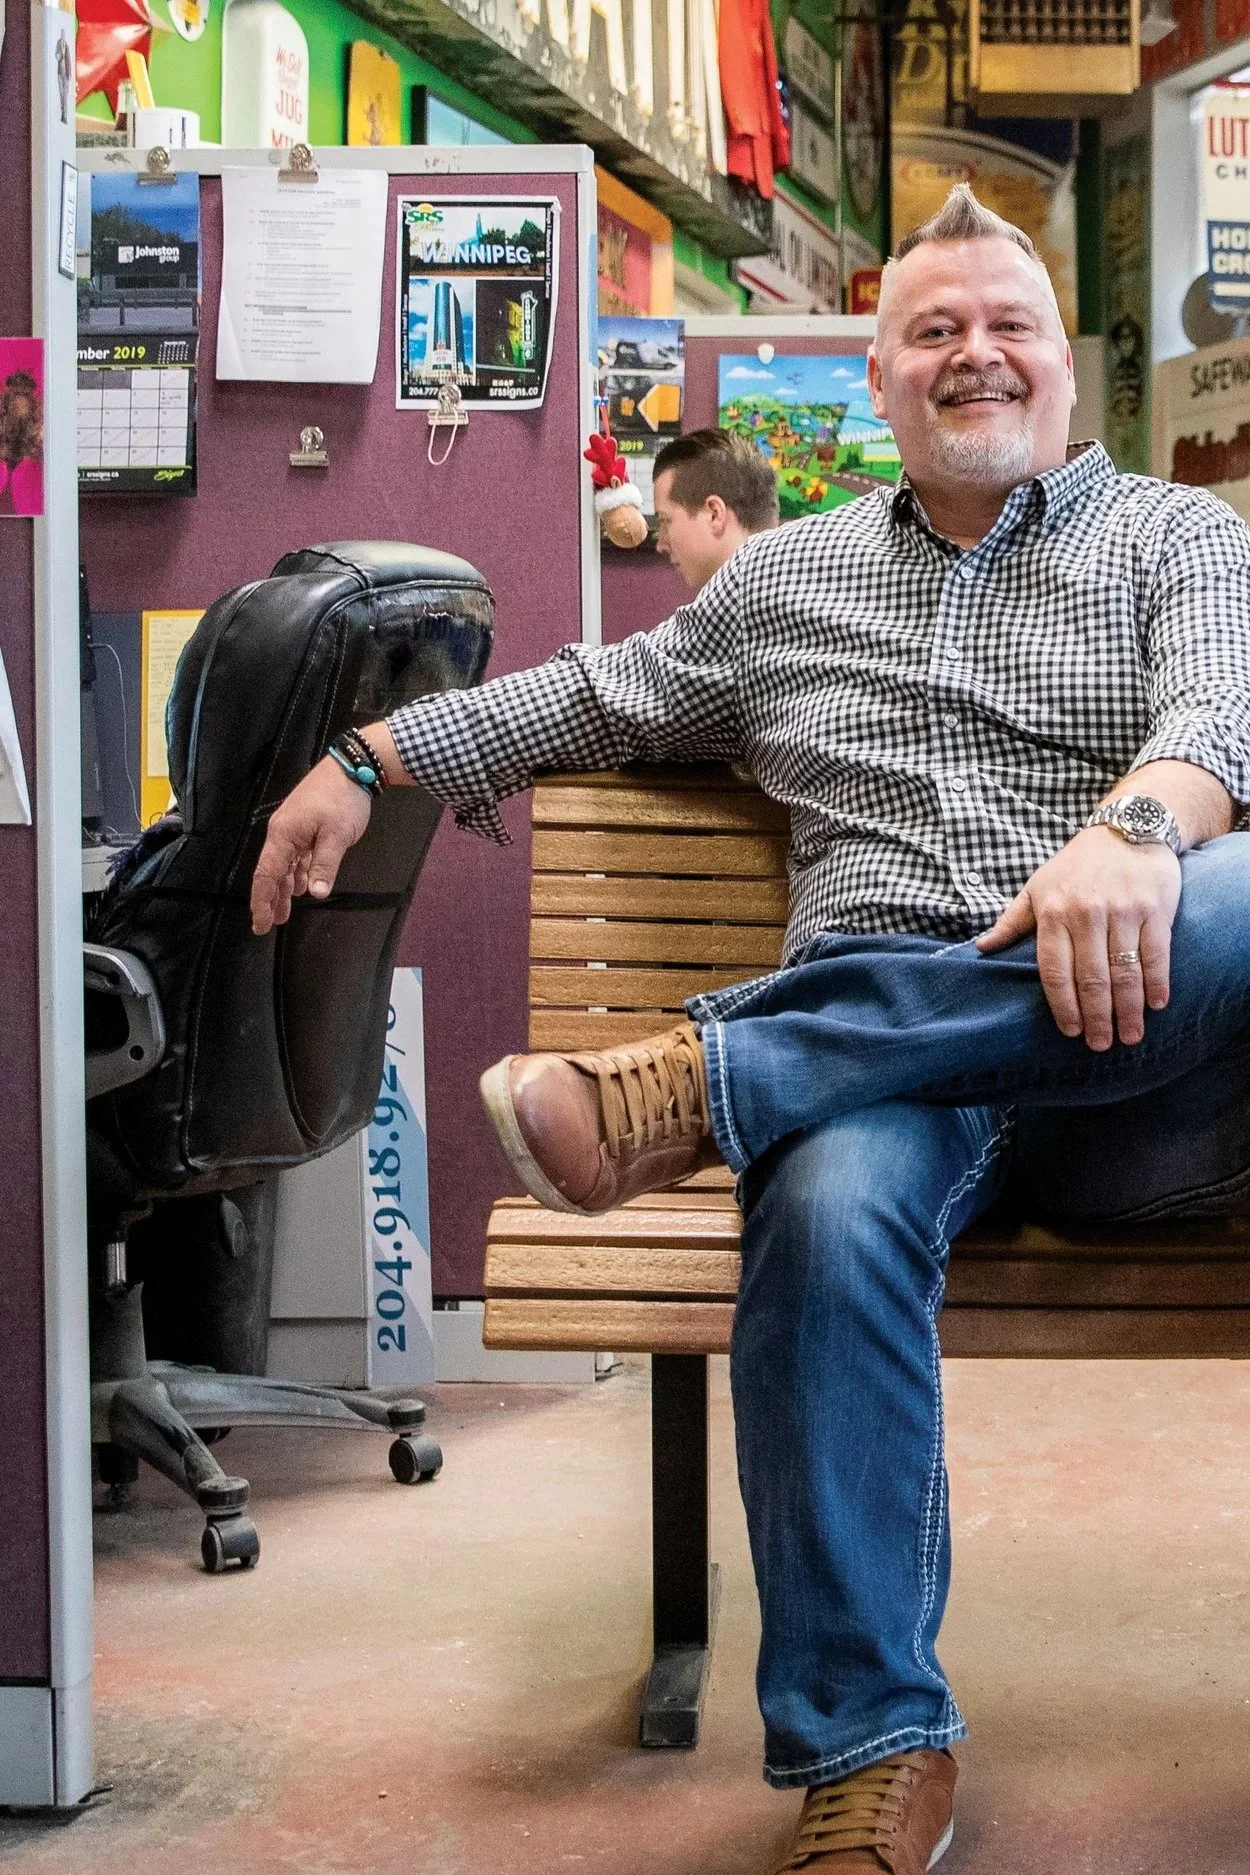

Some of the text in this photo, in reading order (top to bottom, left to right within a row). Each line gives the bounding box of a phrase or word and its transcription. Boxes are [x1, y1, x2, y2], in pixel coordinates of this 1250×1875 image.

[275, 88, 302, 125] JUG
[65, 195, 76, 270] RECYCLE
[135, 245, 180, 260] Johnston
[158, 255, 180, 264] group
[421, 242, 531, 264] WINNIPEG
[77, 346, 110, 360] mber
[113, 346, 146, 360] 2019
[489, 386, 539, 399] srssigns.co
[837, 427, 893, 446] WINNIP
[619, 440, 644, 452] 2019
[369, 1003, 412, 1352] 204.918.92
